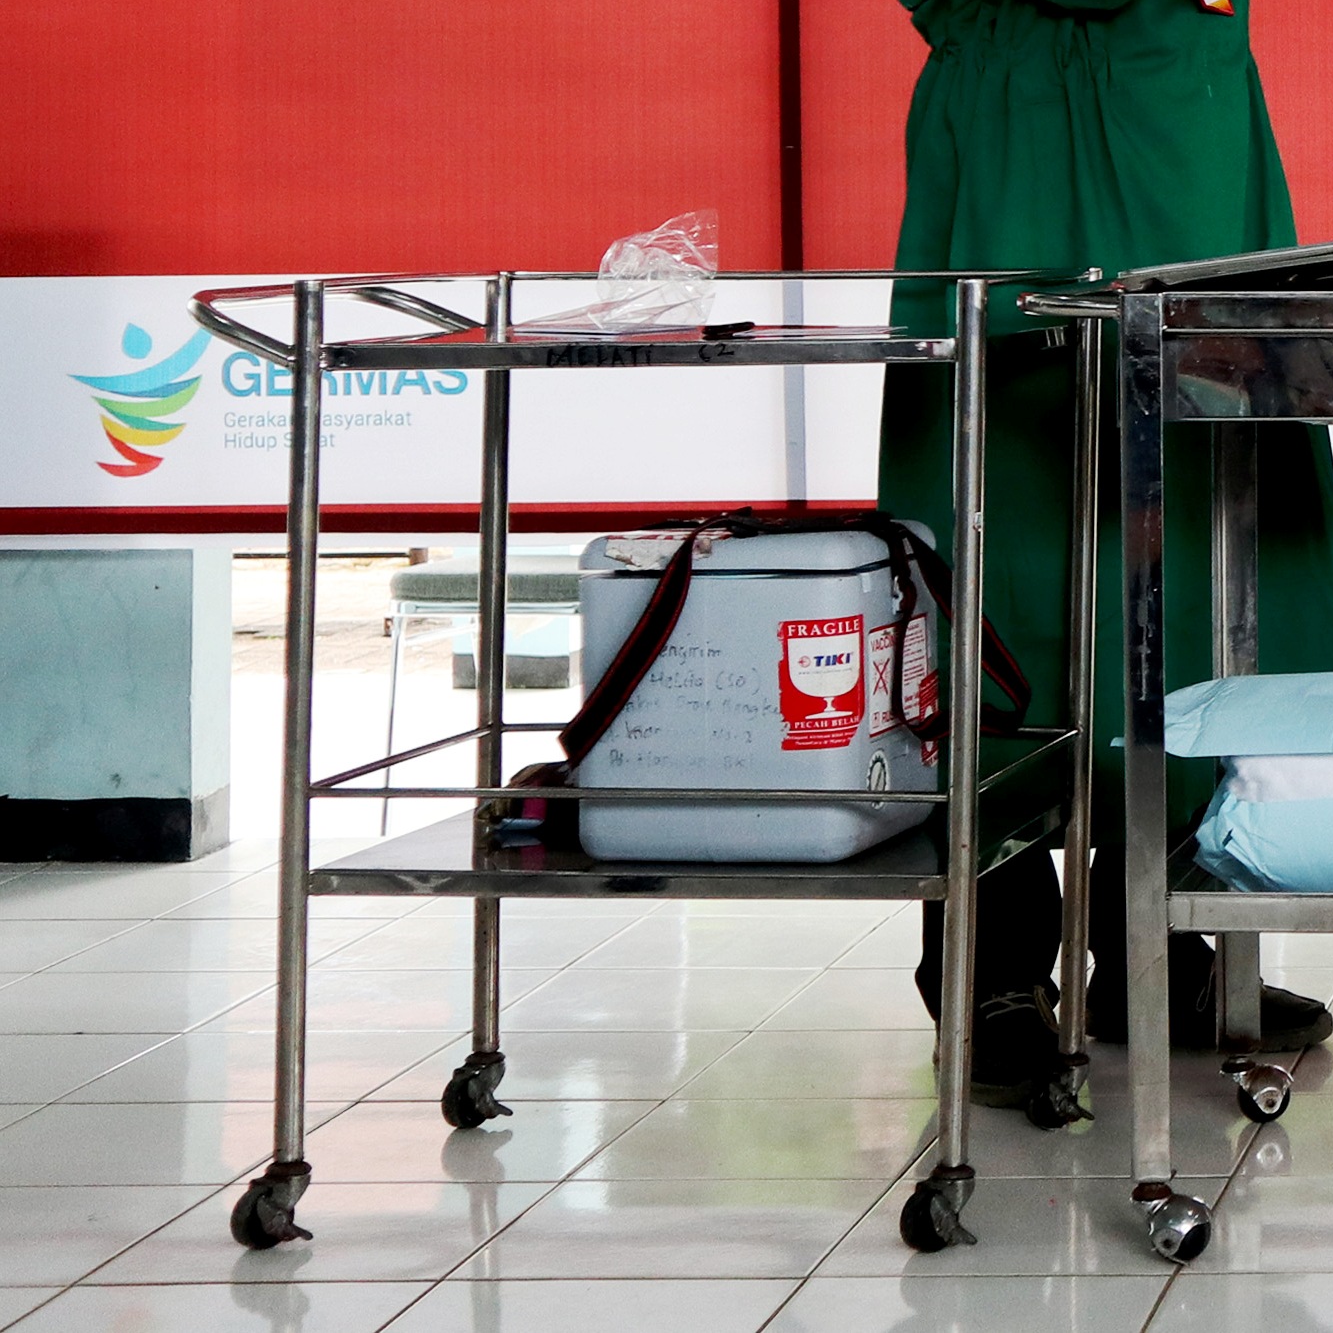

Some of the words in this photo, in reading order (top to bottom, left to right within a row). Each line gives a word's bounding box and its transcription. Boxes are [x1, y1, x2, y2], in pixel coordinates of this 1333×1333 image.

[224, 411, 291, 428] Geraka
[322, 410, 412, 431] asyarakat
[224, 432, 277, 451] Hidup
[283, 433, 335, 448] Sat
[787, 618, 860, 637] FRAGILE
[813, 653, 851, 667] TIKI
[794, 721, 828, 729] PECAH
